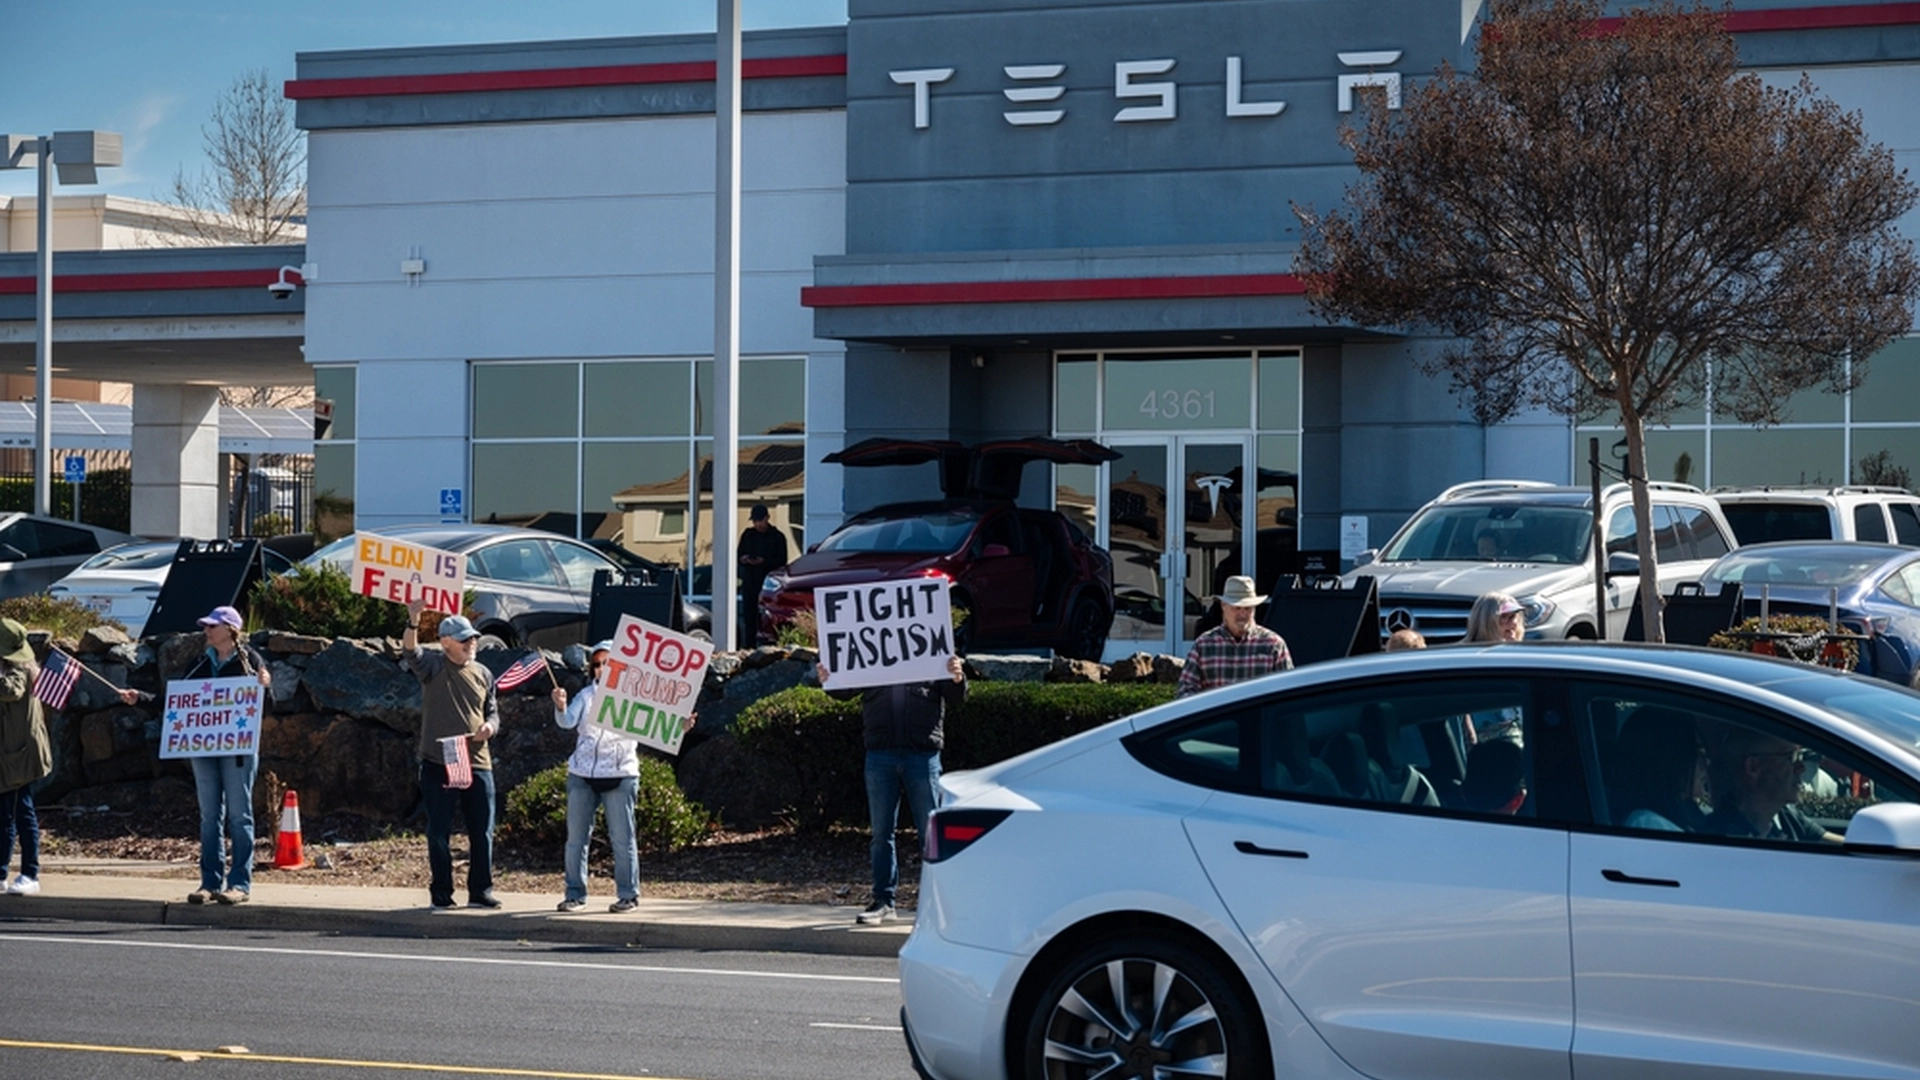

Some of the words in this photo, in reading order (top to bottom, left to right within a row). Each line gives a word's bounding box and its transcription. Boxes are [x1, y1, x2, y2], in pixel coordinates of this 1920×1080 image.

[889, 51, 1402, 128] TESLA
[1140, 389, 1215, 419] 4361
[360, 539, 423, 571] ELON
[434, 554, 457, 578] IS
[411, 572, 422, 584] A
[362, 567, 459, 615] FELON
[825, 583, 940, 624] FIGHT
[620, 624, 706, 678] STOP
[827, 623, 950, 673] FASCISM
[168, 693, 201, 709] FIRE
[213, 686, 258, 707] ELON
[605, 658, 692, 706] TRUMP
[186, 710, 232, 728] FIGHT
[167, 731, 253, 753] FASCISM
